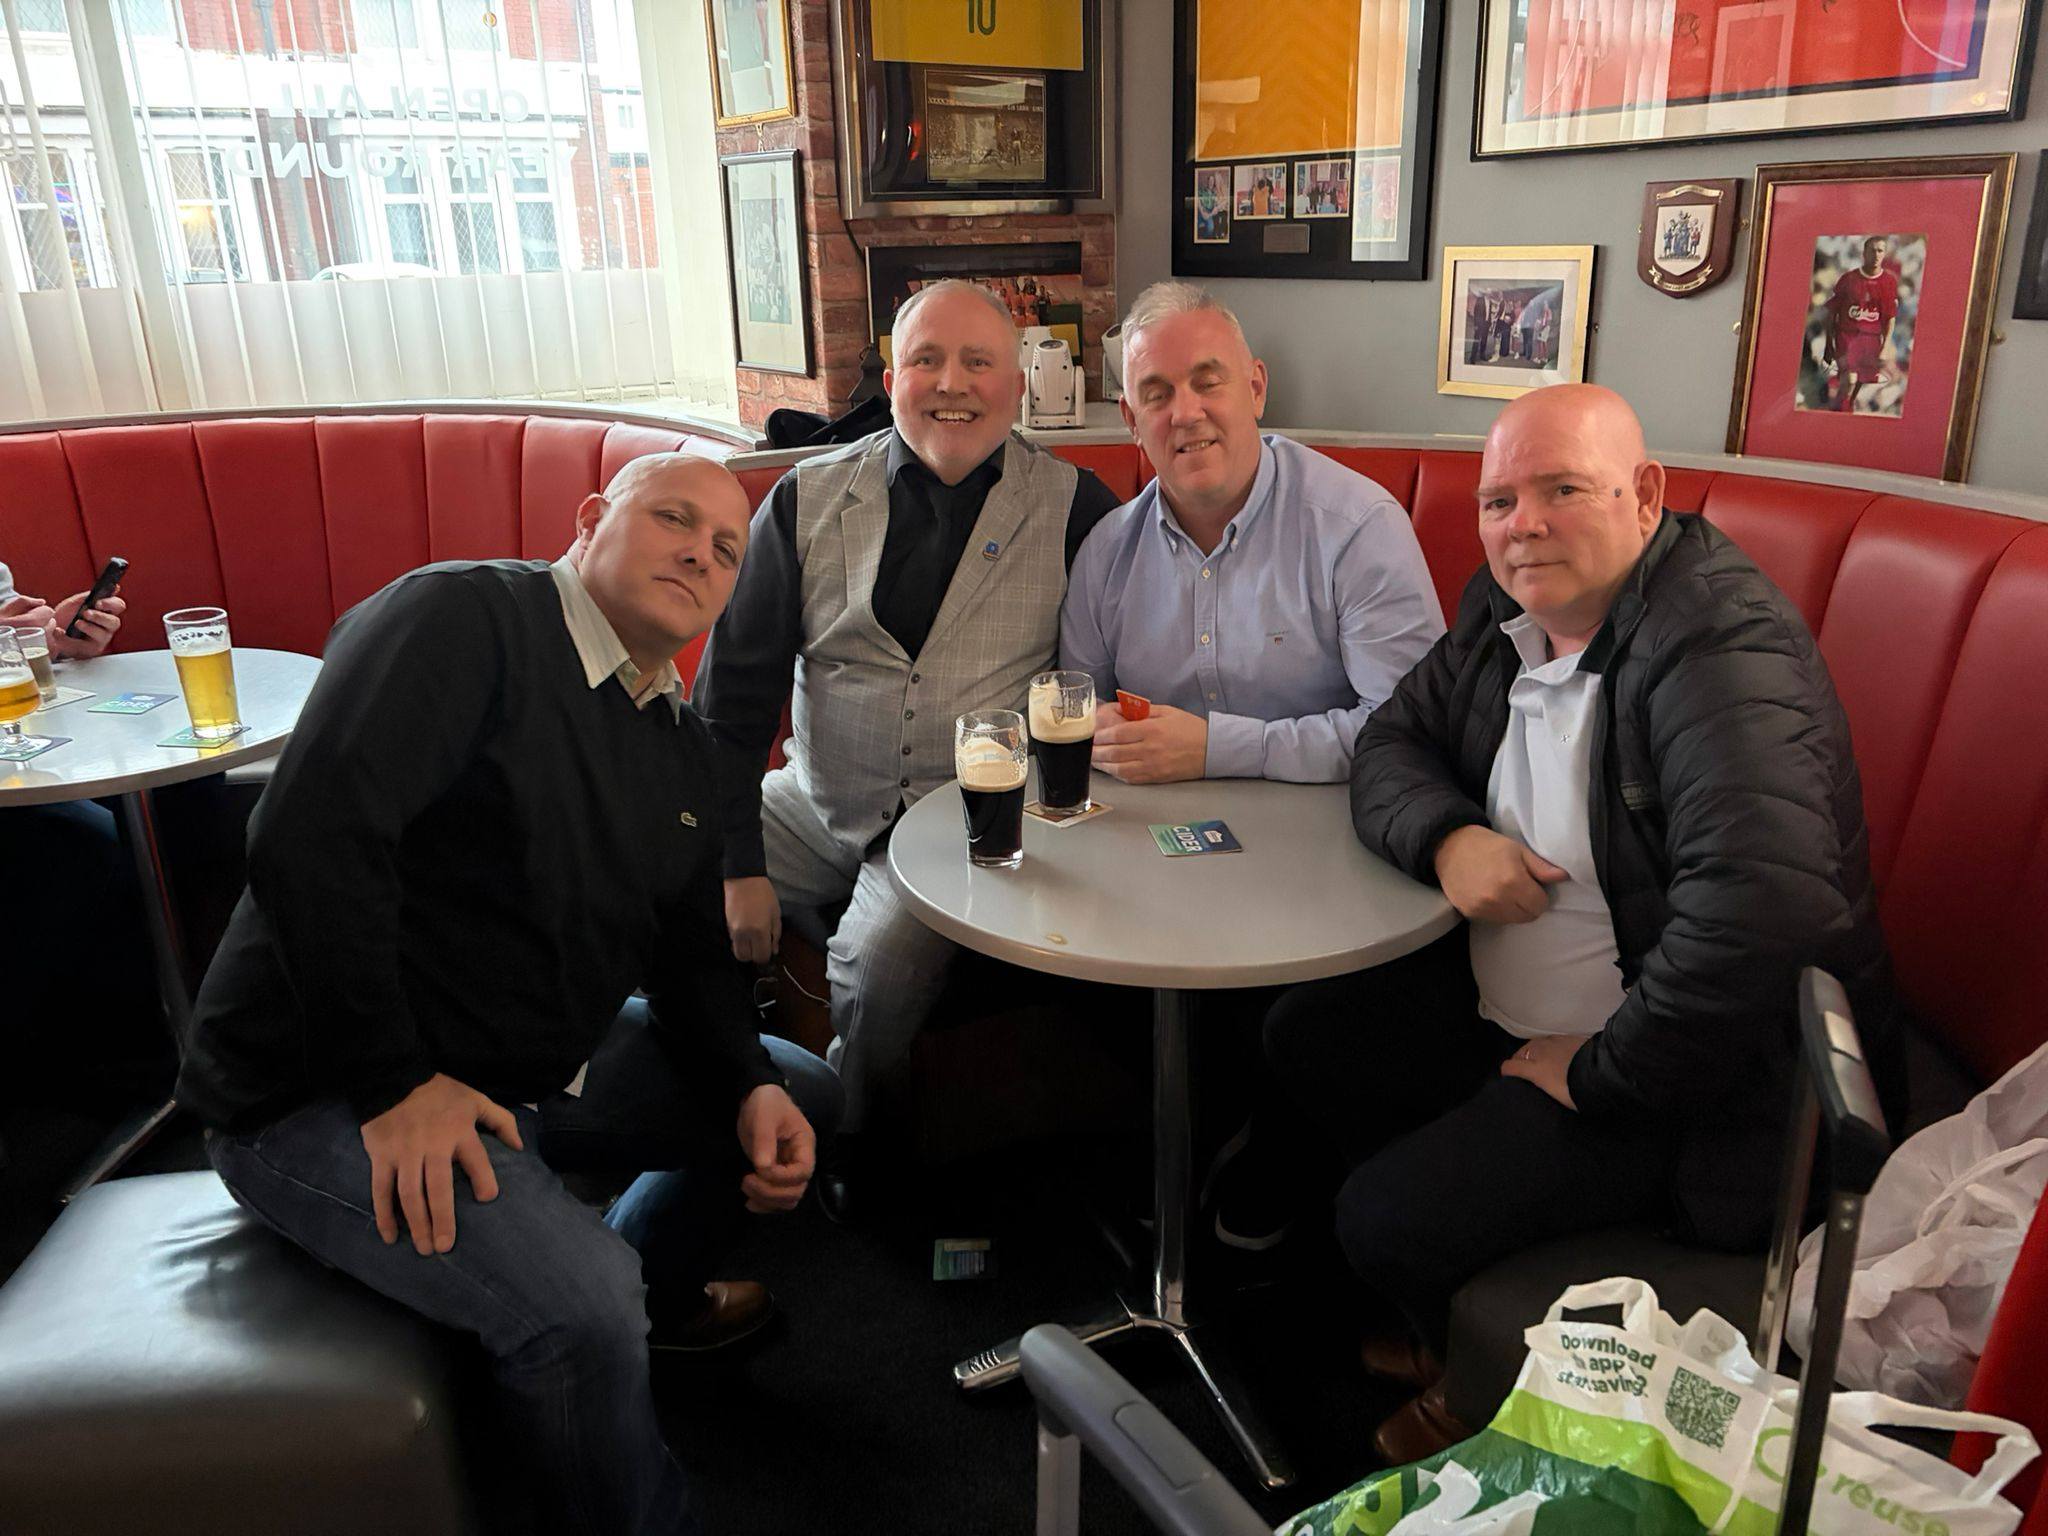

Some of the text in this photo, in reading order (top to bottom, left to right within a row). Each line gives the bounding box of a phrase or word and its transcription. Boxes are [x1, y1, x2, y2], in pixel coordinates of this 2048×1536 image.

[968, 0, 996, 35] 10
[1173, 826, 1203, 852] CIDER
[1560, 1333, 1657, 1370] Download
[1588, 1357, 1625, 1374] app
[1832, 1473, 1951, 1536] reuse
